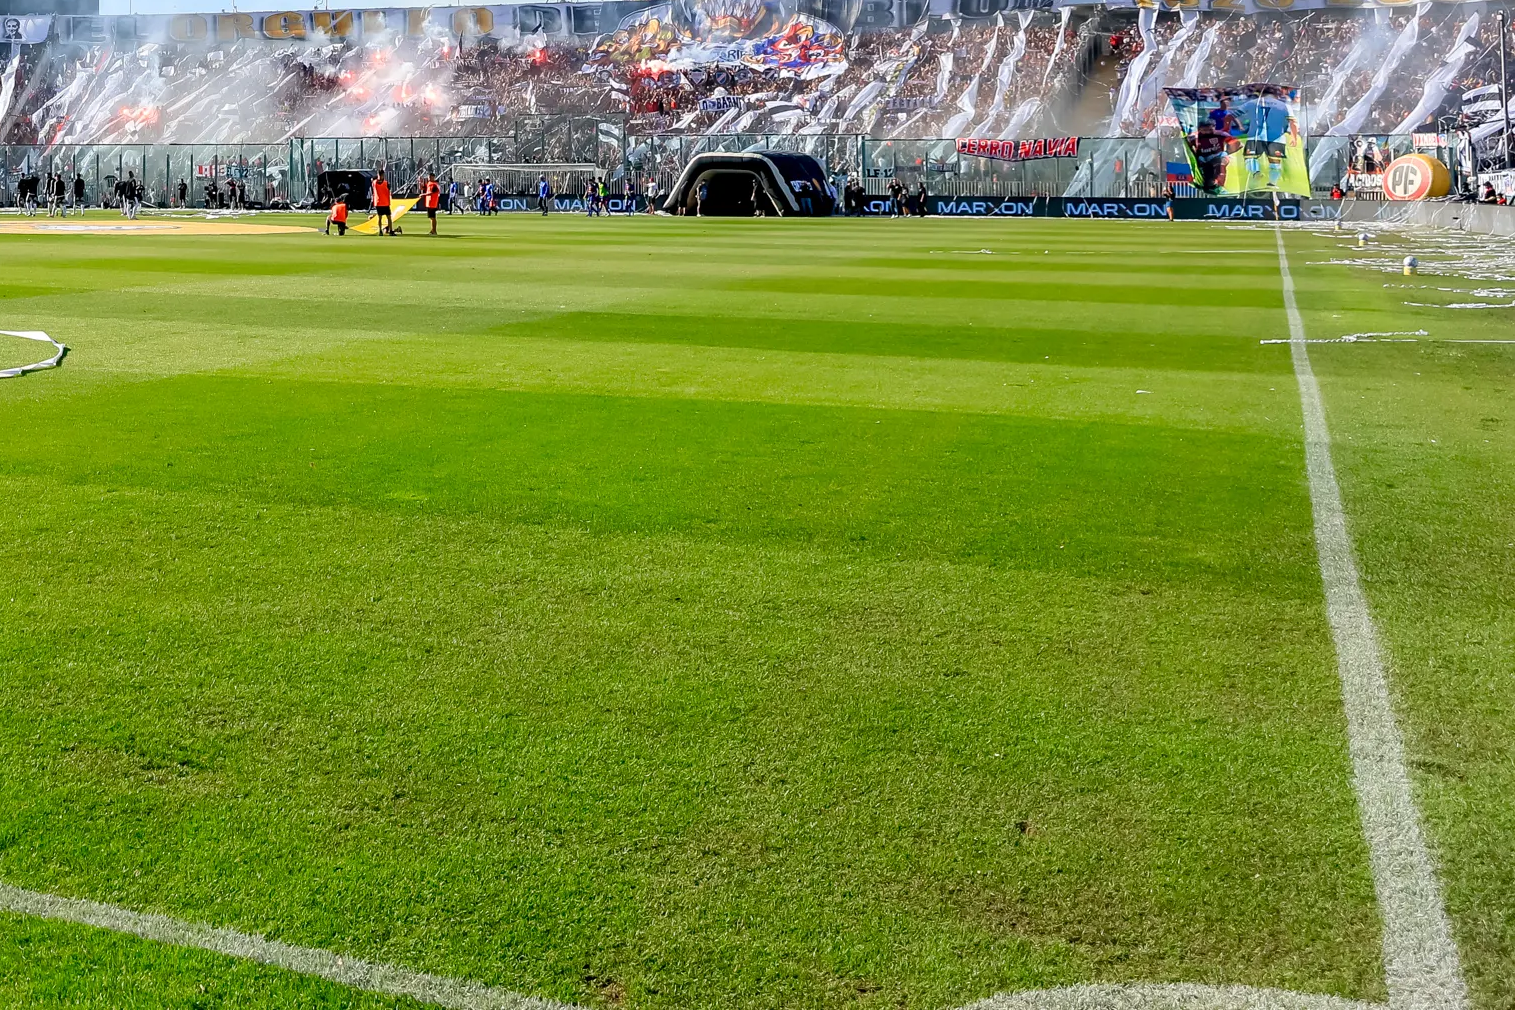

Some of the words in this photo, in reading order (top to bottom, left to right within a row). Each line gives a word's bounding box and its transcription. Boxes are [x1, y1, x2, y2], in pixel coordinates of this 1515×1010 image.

[955, 137, 1015, 160] CERRO
[1018, 137, 1079, 159] NAVIA
[1392, 165, 1417, 195] PF
[555, 198, 635, 210] MAON
